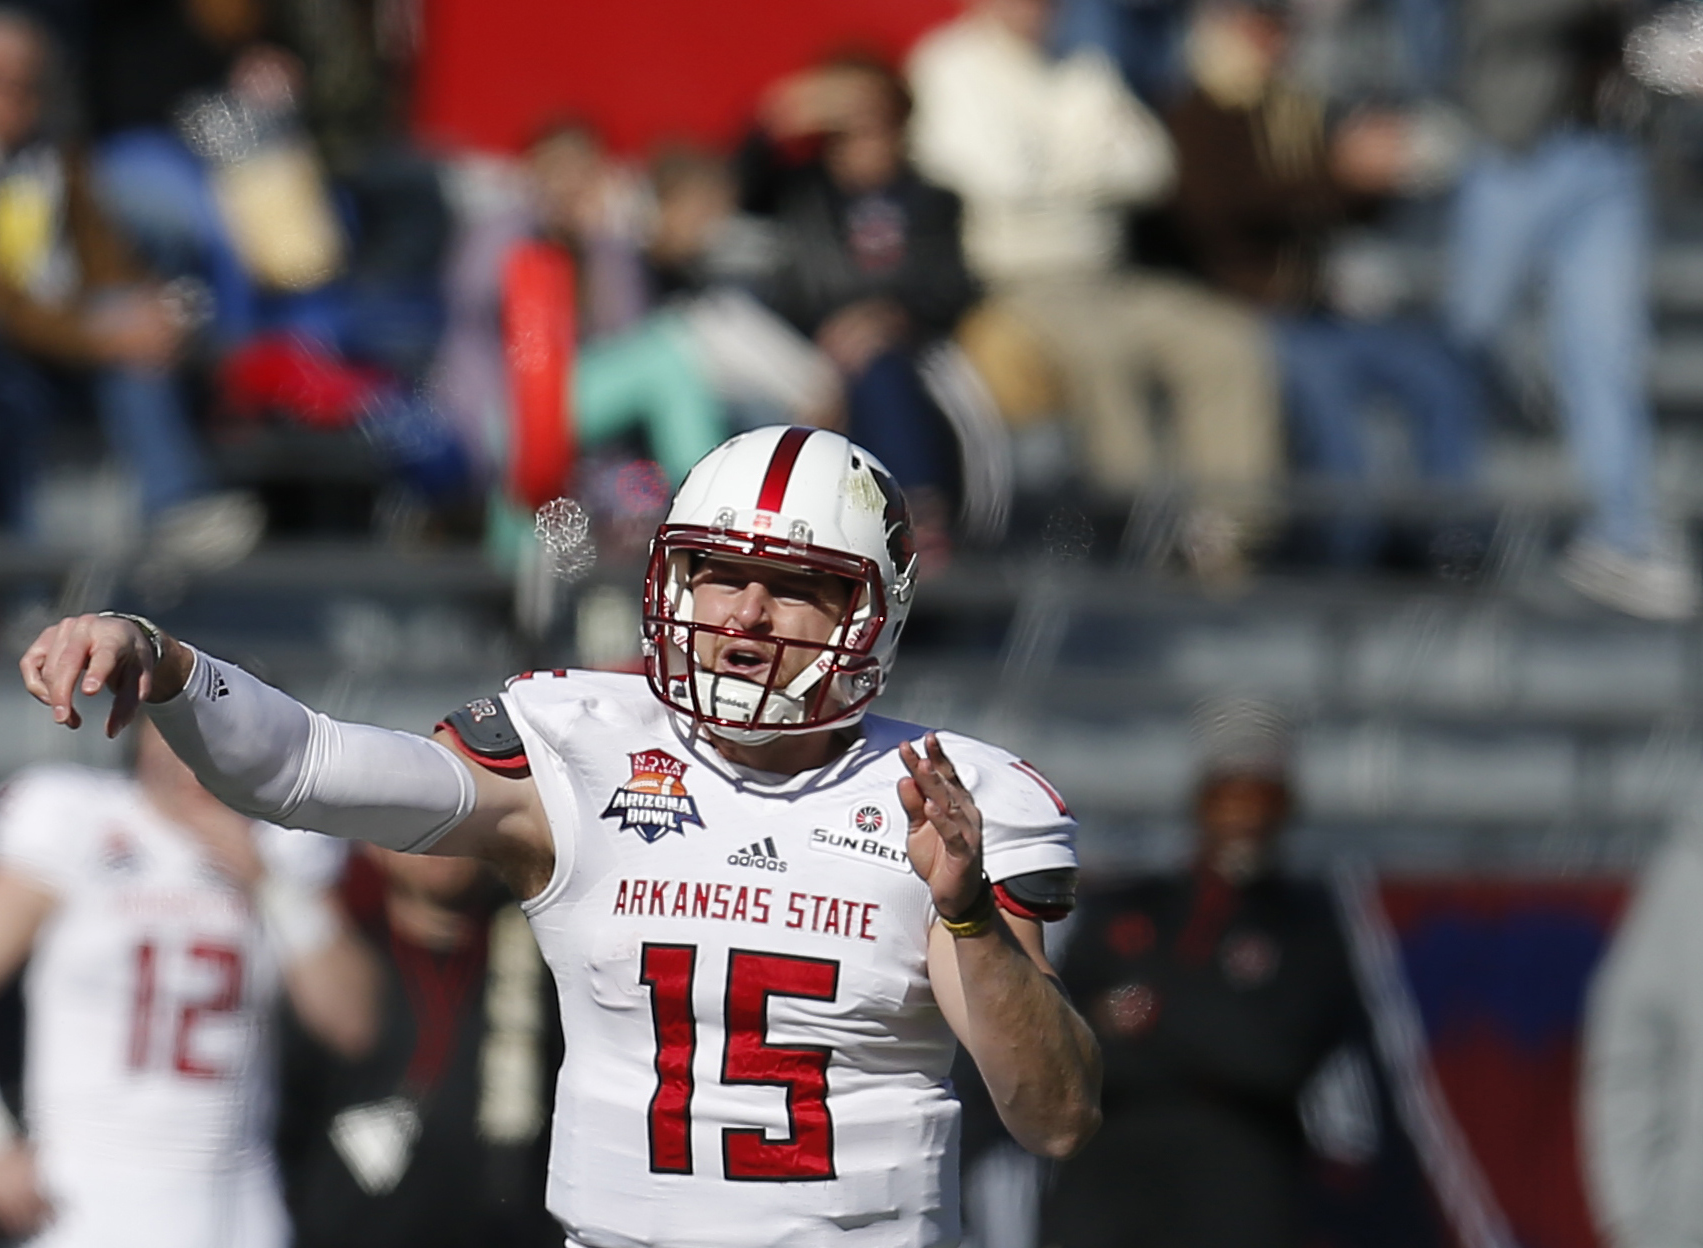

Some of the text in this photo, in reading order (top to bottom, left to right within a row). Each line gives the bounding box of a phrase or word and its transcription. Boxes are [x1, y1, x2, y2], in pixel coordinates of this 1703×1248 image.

[635, 754, 683, 771] NOVA
[612, 790, 693, 815] ARIZONA
[626, 808, 678, 828] BOWL
[727, 853, 788, 873] adidas
[613, 879, 880, 941] ARKANSAS STATE
[125, 937, 244, 1079] 12
[638, 941, 841, 1182] 15
